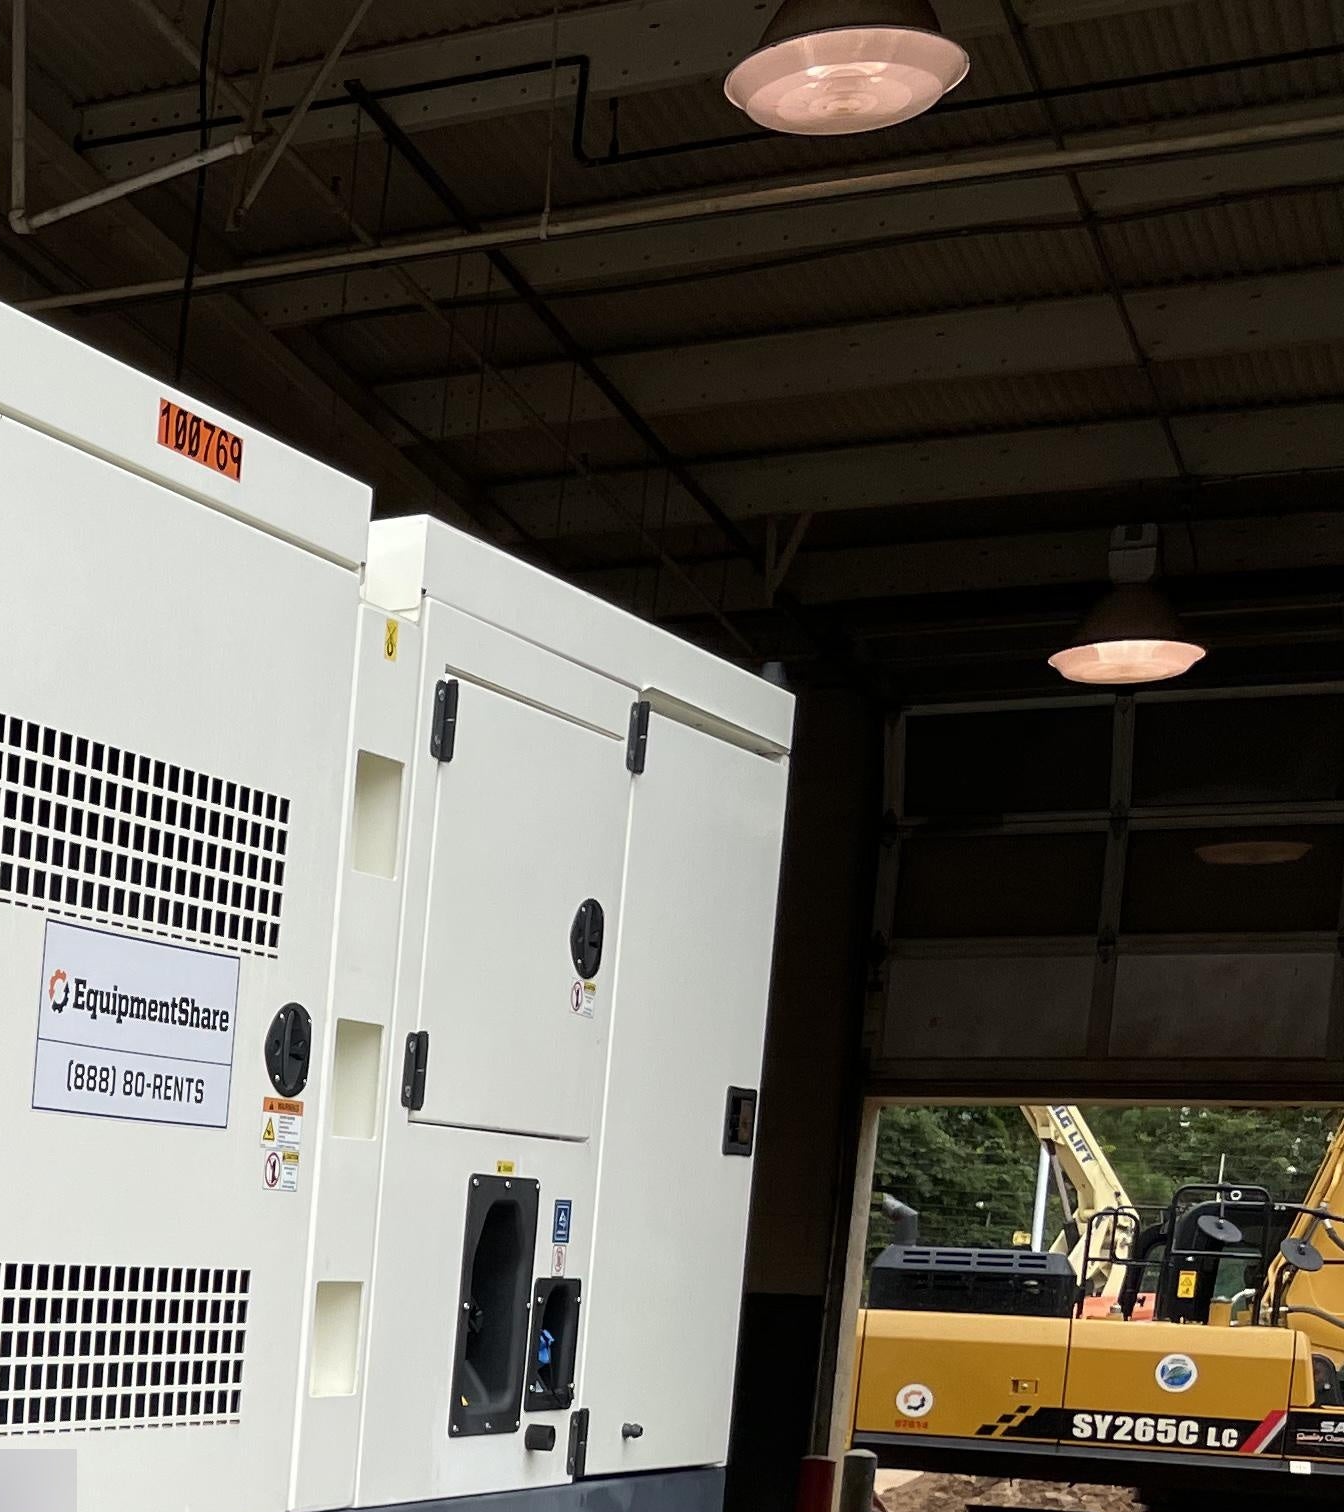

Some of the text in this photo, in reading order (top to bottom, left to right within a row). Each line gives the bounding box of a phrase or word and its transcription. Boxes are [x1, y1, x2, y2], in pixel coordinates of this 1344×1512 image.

[160, 401, 243, 479] 100769
[72, 977, 230, 1034] EquipmentShare
[66, 1059, 204, 1104] (888) 80-RENTS
[1072, 1414, 1239, 1449] SY265C LC
